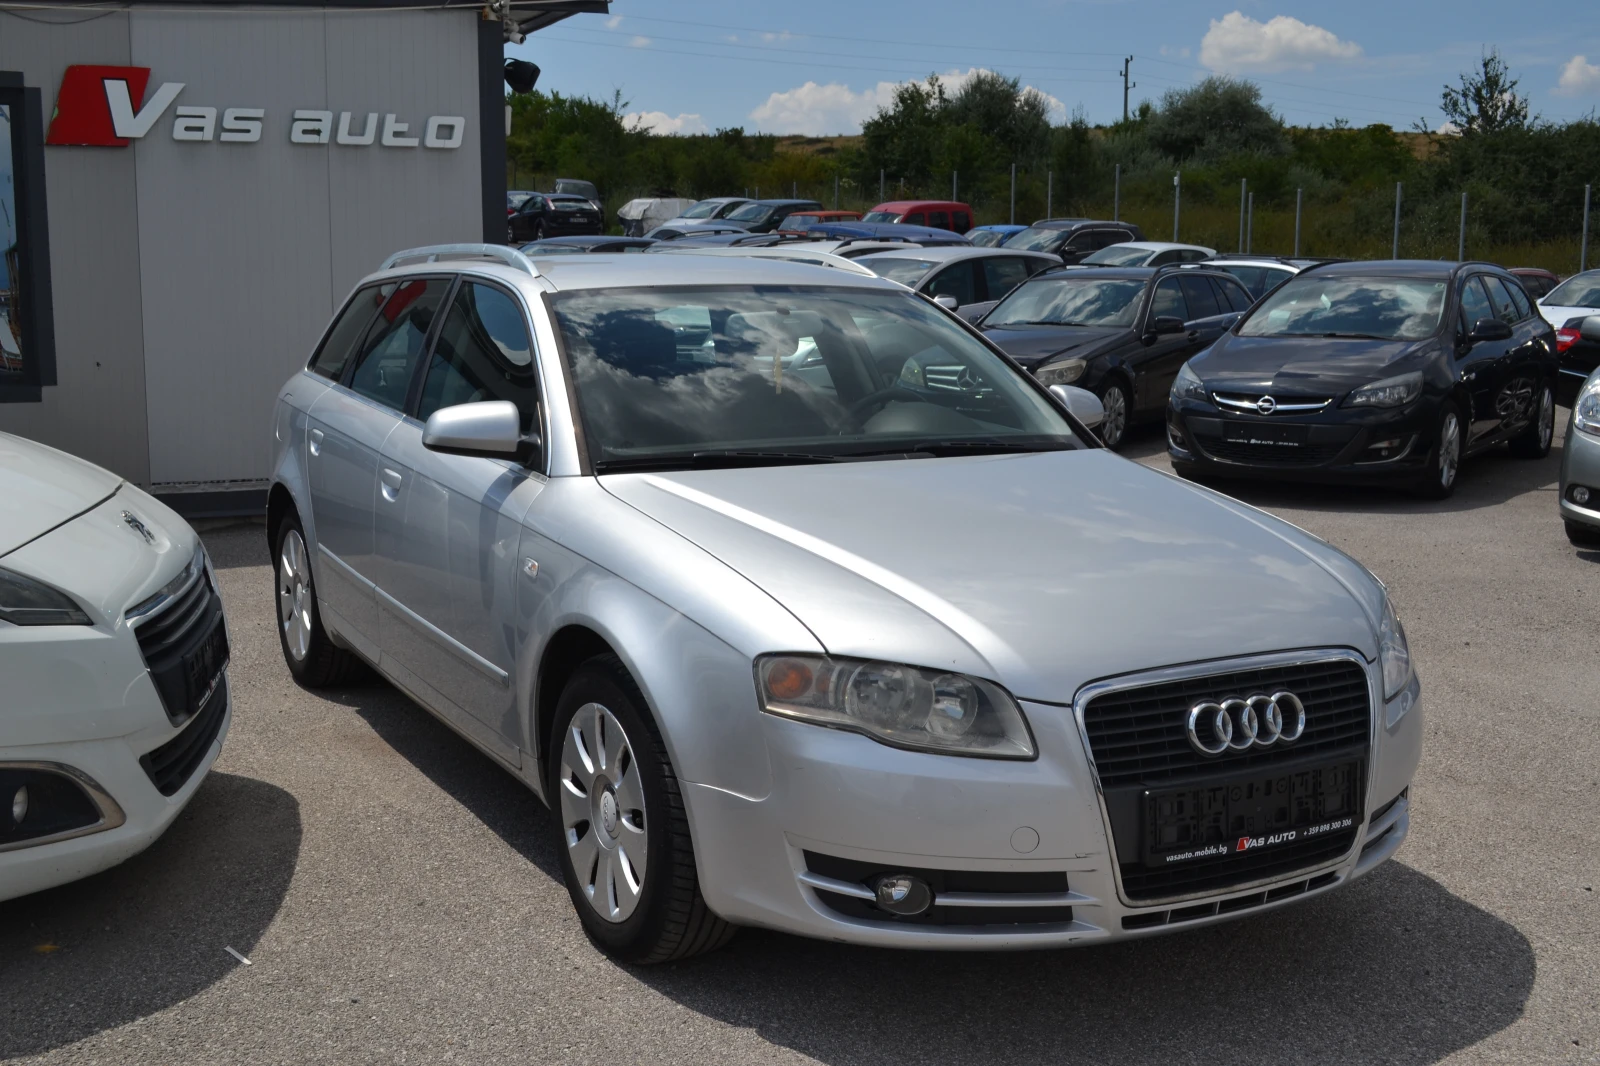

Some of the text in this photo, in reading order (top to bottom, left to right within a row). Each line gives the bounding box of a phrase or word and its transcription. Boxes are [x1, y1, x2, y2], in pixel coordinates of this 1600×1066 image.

[101, 77, 466, 149] Vas auto
[1165, 843, 1228, 862] vasauto.mobile.bg
[1244, 837, 1265, 850] VAS
[1266, 831, 1296, 845] AUTO
